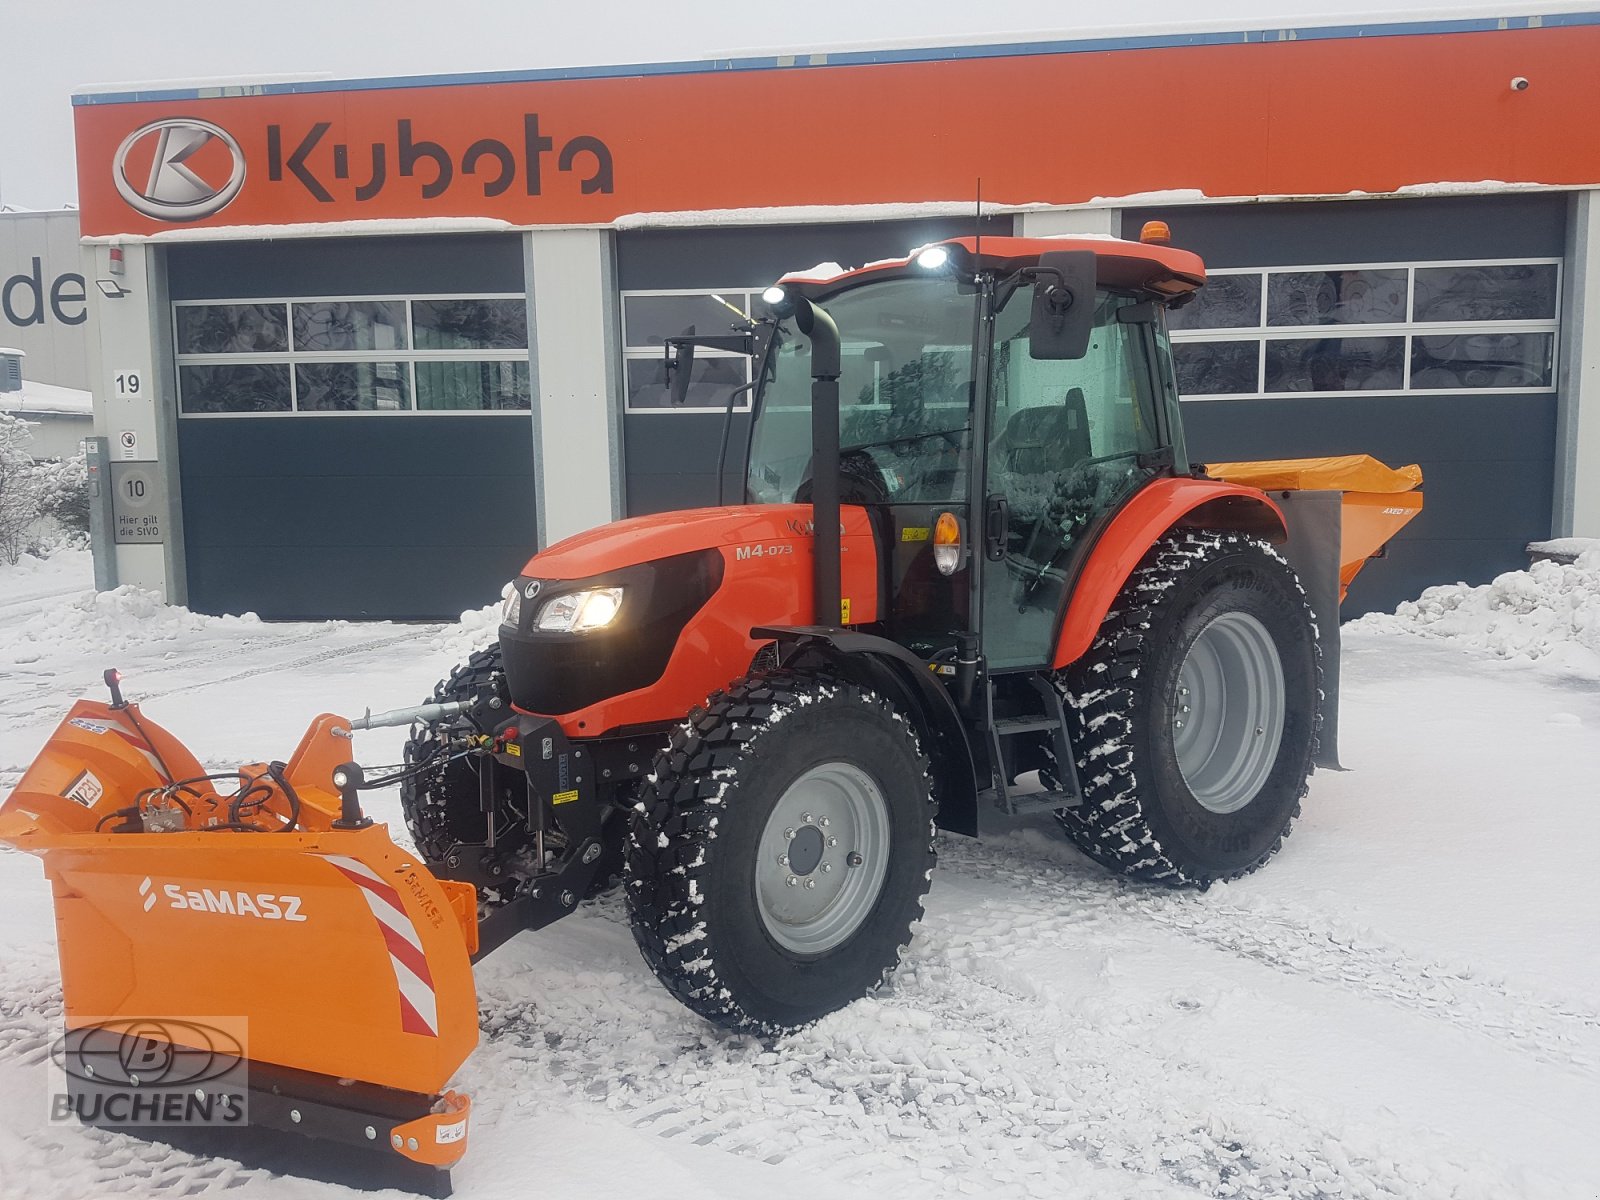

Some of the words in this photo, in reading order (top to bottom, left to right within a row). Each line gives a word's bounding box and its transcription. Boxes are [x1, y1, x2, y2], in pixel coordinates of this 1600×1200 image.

[267, 113, 614, 203] Kubota
[2, 256, 88, 327] de
[116, 374, 140, 394] 19
[127, 480, 145, 497] 10
[119, 515, 139, 525] Hier
[143, 515, 158, 527] gilt
[120, 527, 134, 536] die
[137, 526, 159, 536] StVO
[736, 544, 793, 561] M4-073
[163, 884, 308, 922] SaMASZ
